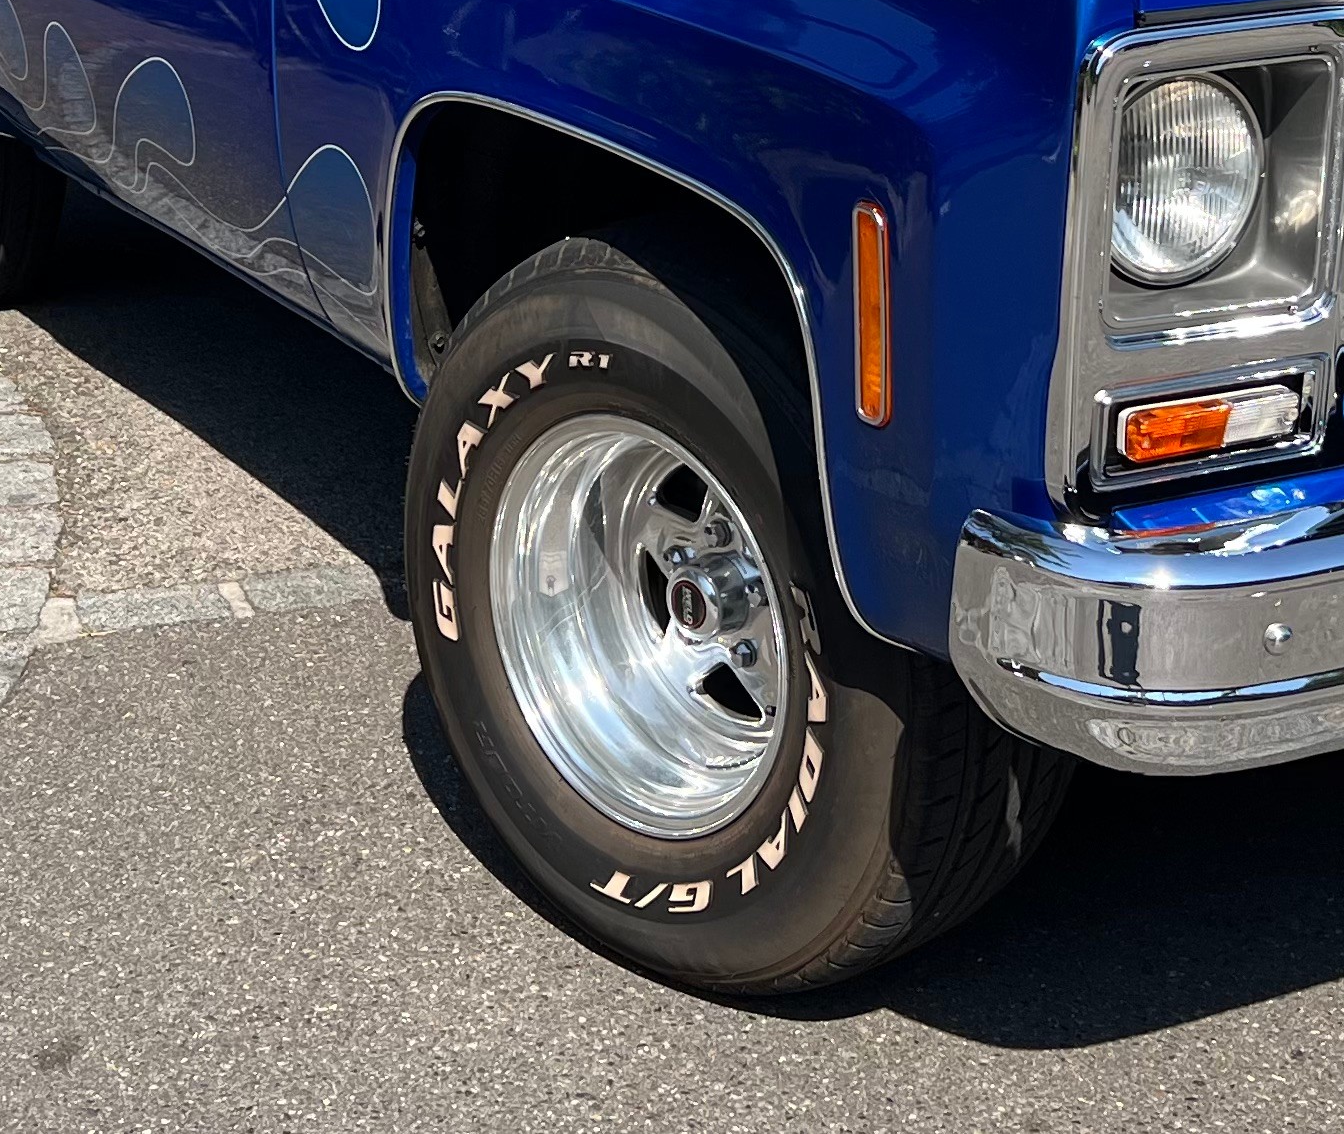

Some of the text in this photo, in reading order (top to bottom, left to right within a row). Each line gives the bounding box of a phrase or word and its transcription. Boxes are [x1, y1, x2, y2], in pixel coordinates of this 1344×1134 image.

[430, 351, 556, 642] GALAXY
[590, 581, 831, 914] RADIAL G/T
